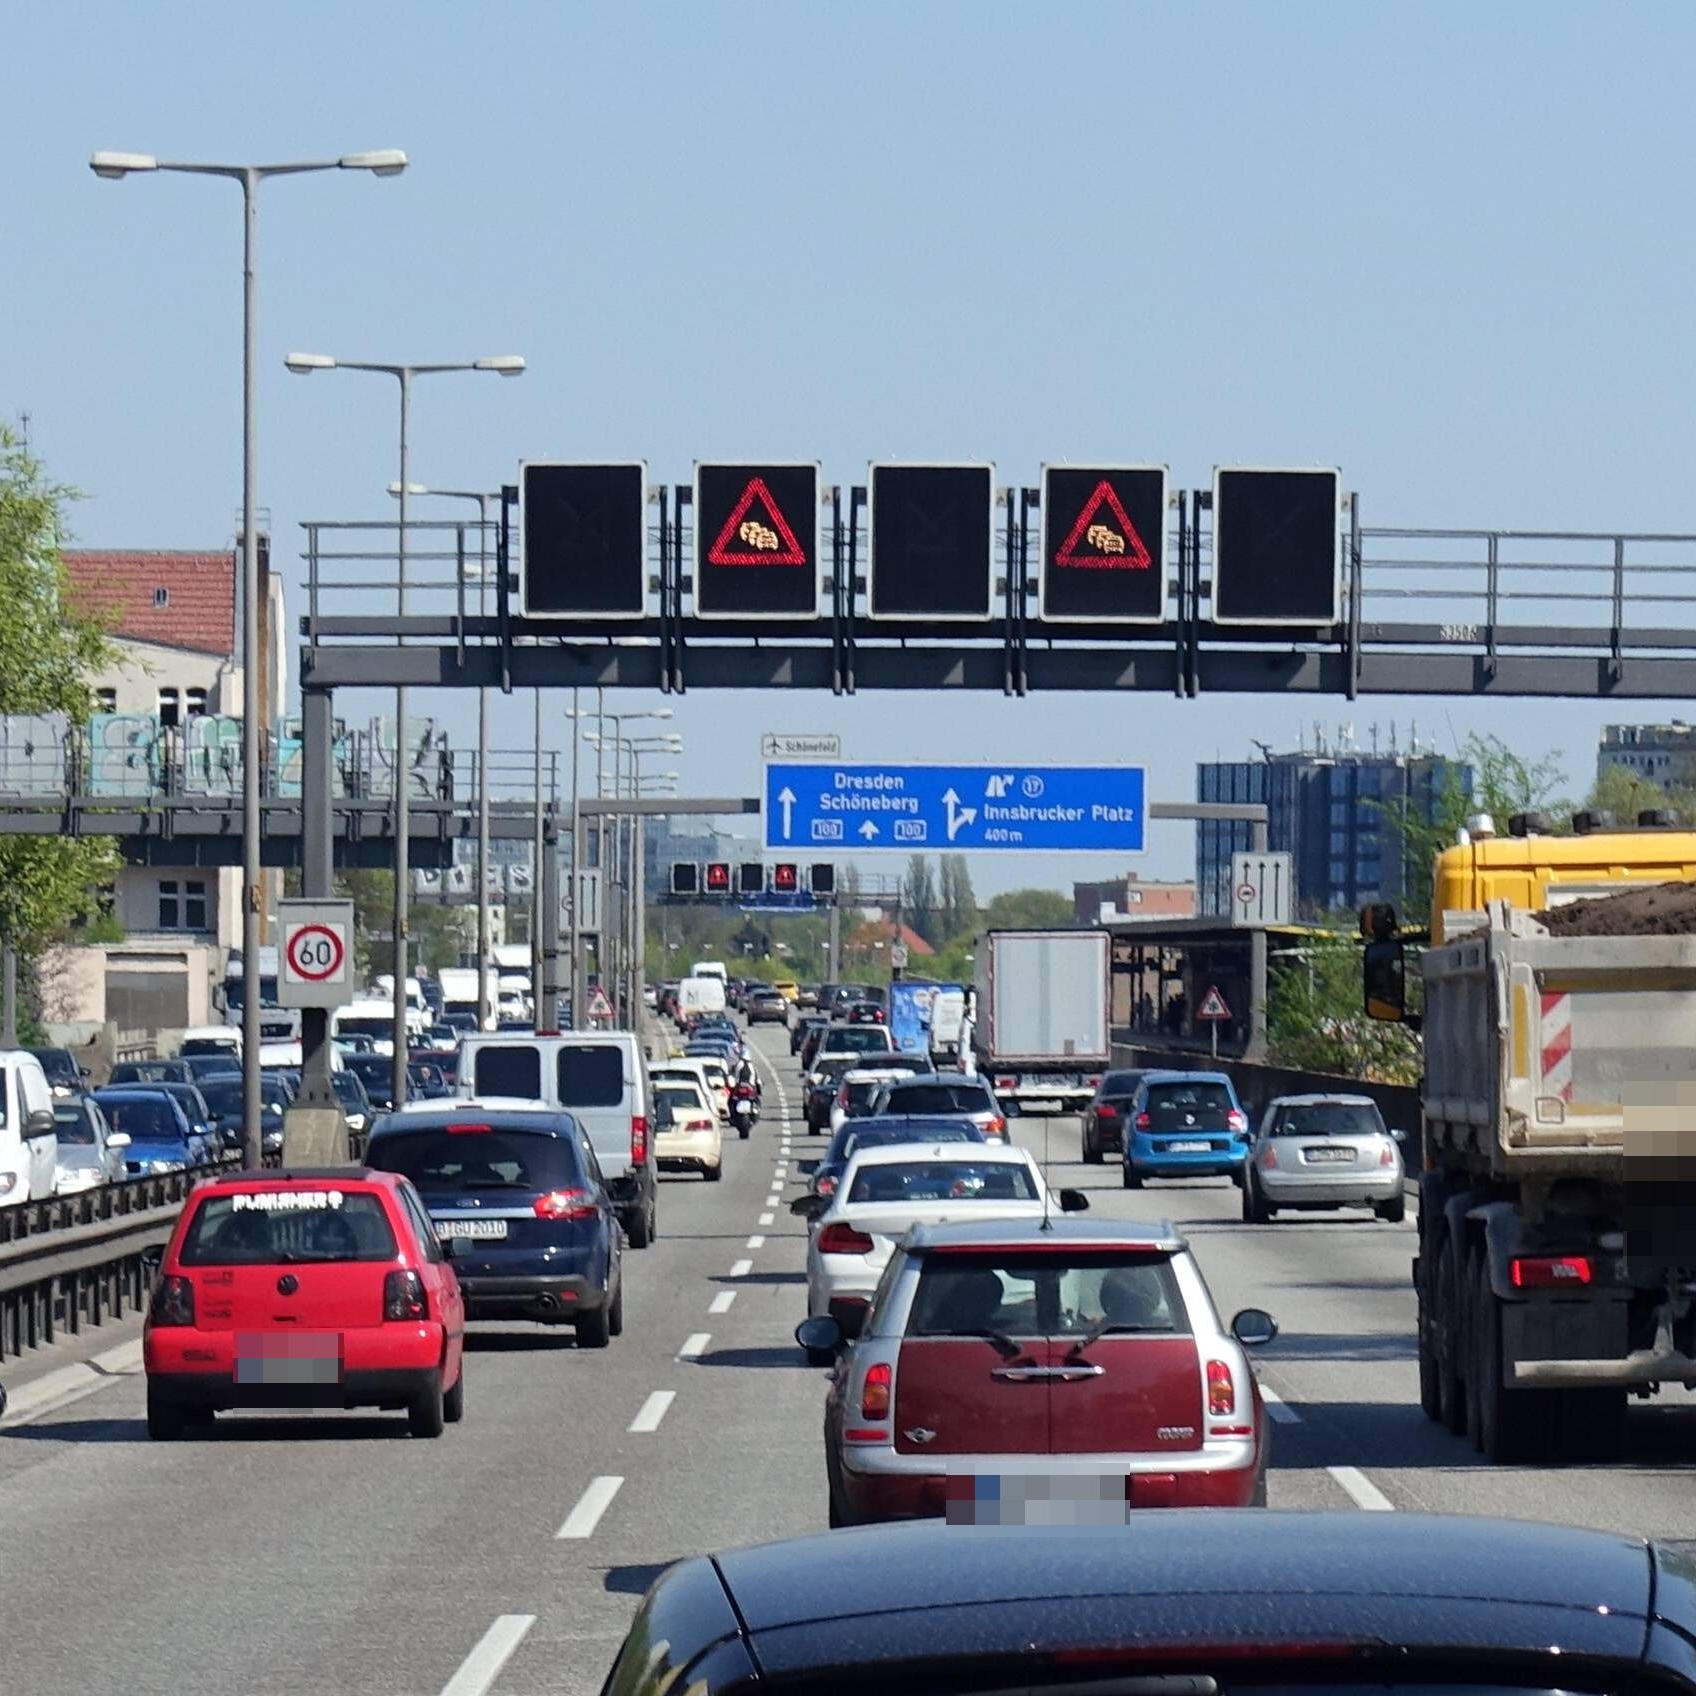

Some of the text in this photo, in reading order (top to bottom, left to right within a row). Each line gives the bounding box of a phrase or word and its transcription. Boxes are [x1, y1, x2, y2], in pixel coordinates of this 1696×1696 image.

[785, 740, 837, 752] Schönefeld
[834, 772, 904, 789] Dresden
[1025, 780, 1039, 792] 17
[819, 793, 919, 814] Schöneberg
[983, 803, 1134, 822] Innsbrucker Platz
[817, 823, 838, 836] 100
[900, 823, 921, 836] 100
[300, 940, 331, 966] 60
